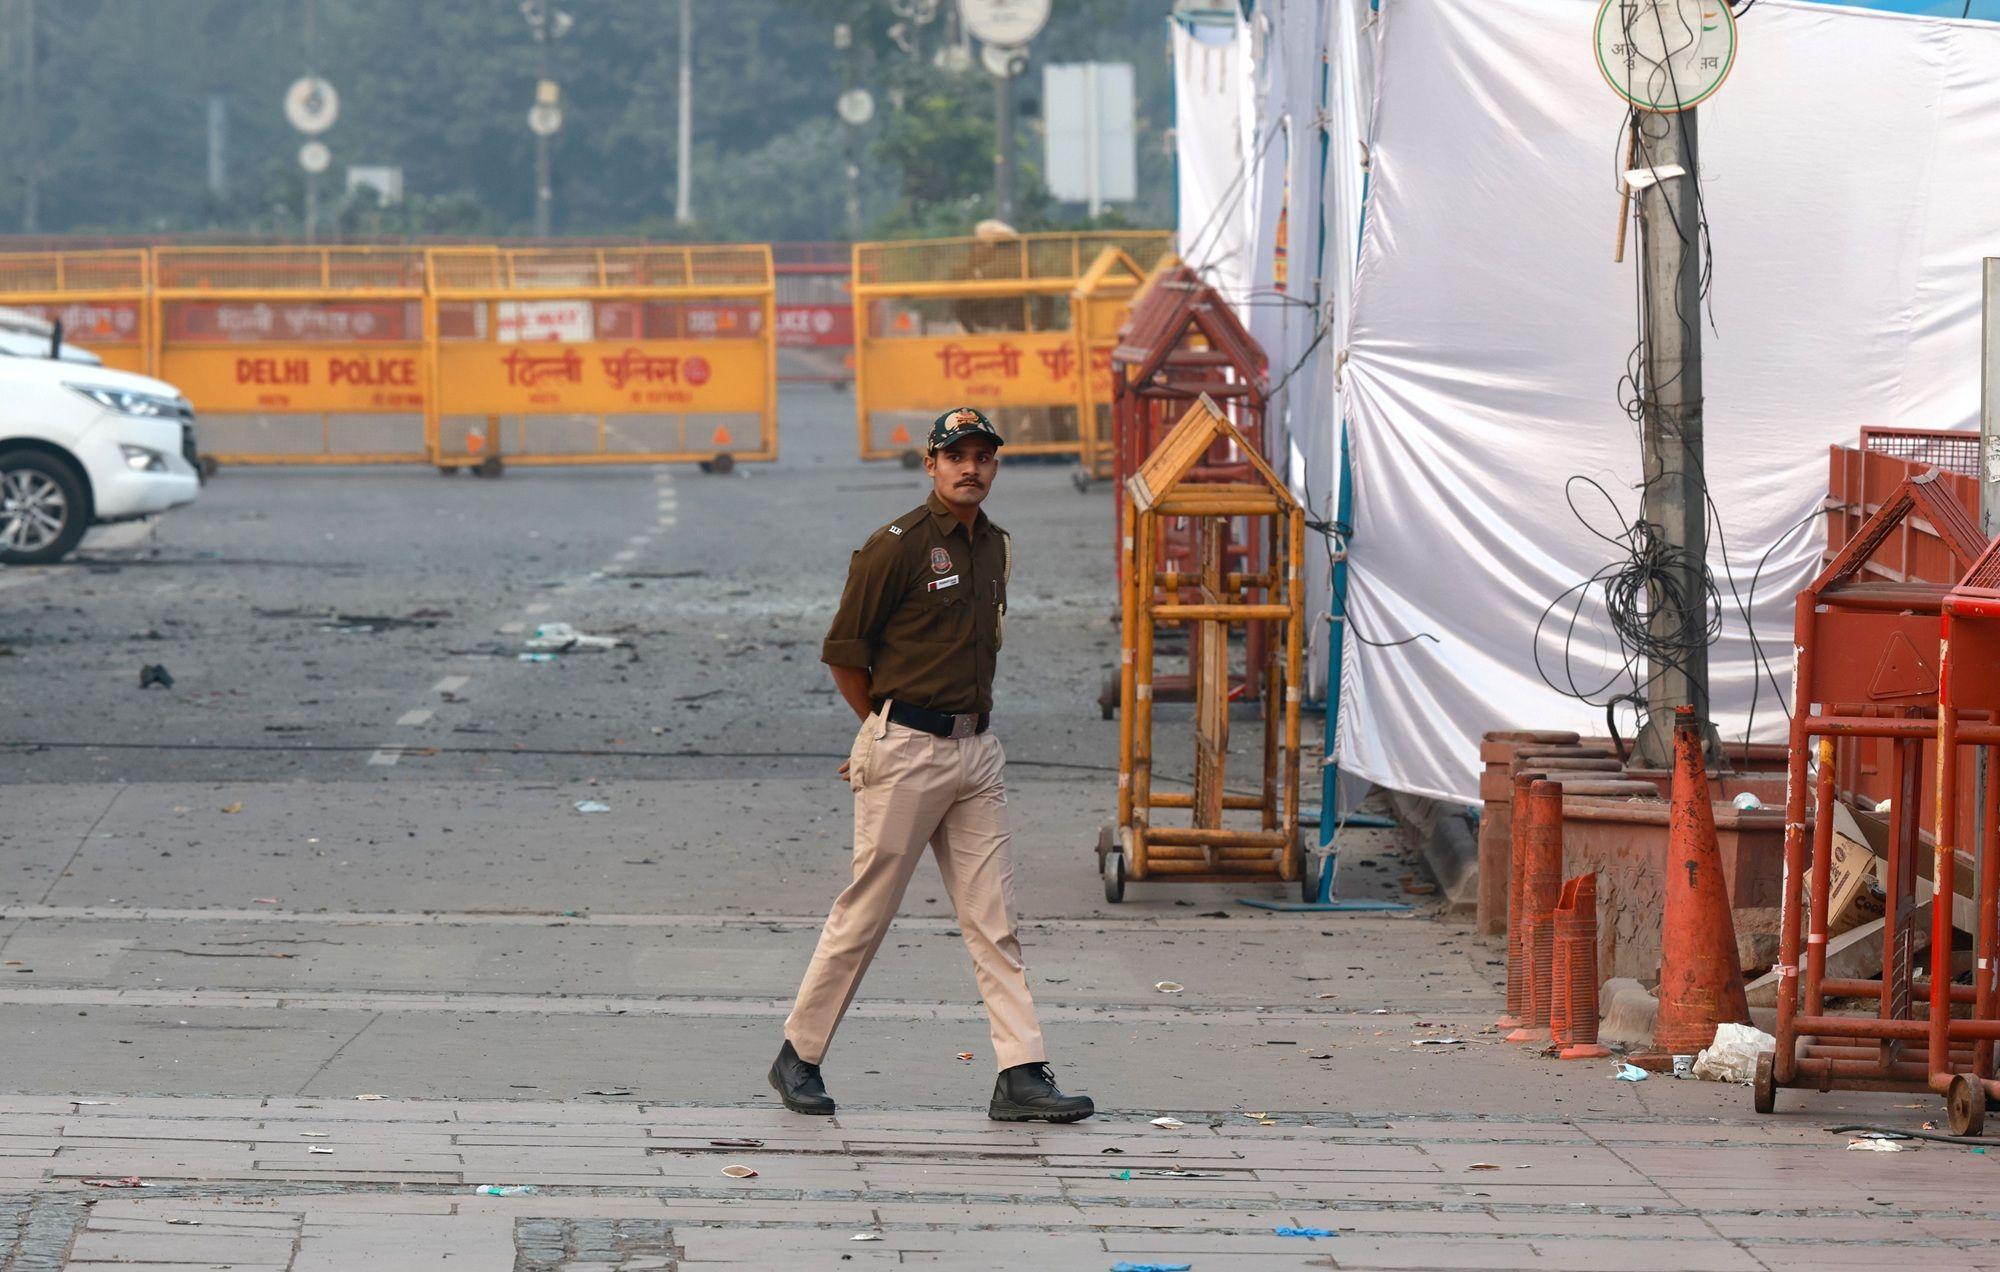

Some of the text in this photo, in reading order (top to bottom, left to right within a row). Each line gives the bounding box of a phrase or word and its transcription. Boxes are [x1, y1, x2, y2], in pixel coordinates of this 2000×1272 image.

[236, 358, 416, 385] DELHI POLICE
[501, 347, 680, 390] दिल्ली पुलिस
